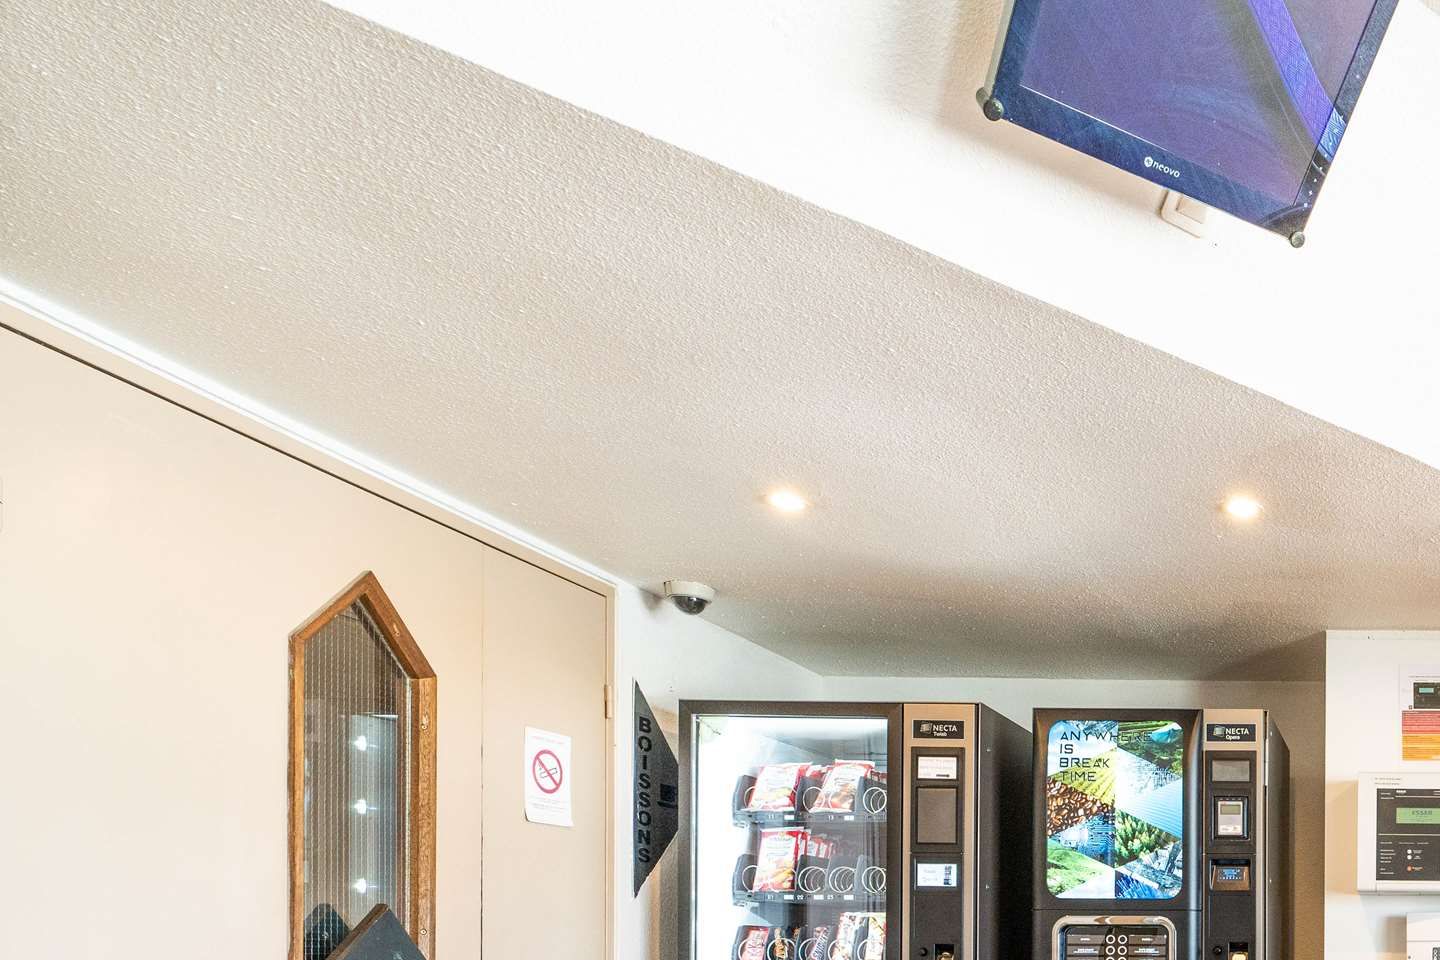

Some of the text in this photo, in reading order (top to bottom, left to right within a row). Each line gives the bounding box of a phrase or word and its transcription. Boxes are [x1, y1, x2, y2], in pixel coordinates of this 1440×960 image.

[1152, 160, 1180, 178] neovo
[932, 724, 958, 732] NECTA
[1225, 727, 1250, 735] NECTA
[1060, 731, 1153, 742] ANYWHERE
[1060, 743, 1074, 755] IS
[1059, 757, 1110, 768] BREAK
[1060, 771, 1097, 782] TIME
[637, 716, 652, 864] BOISSONS
